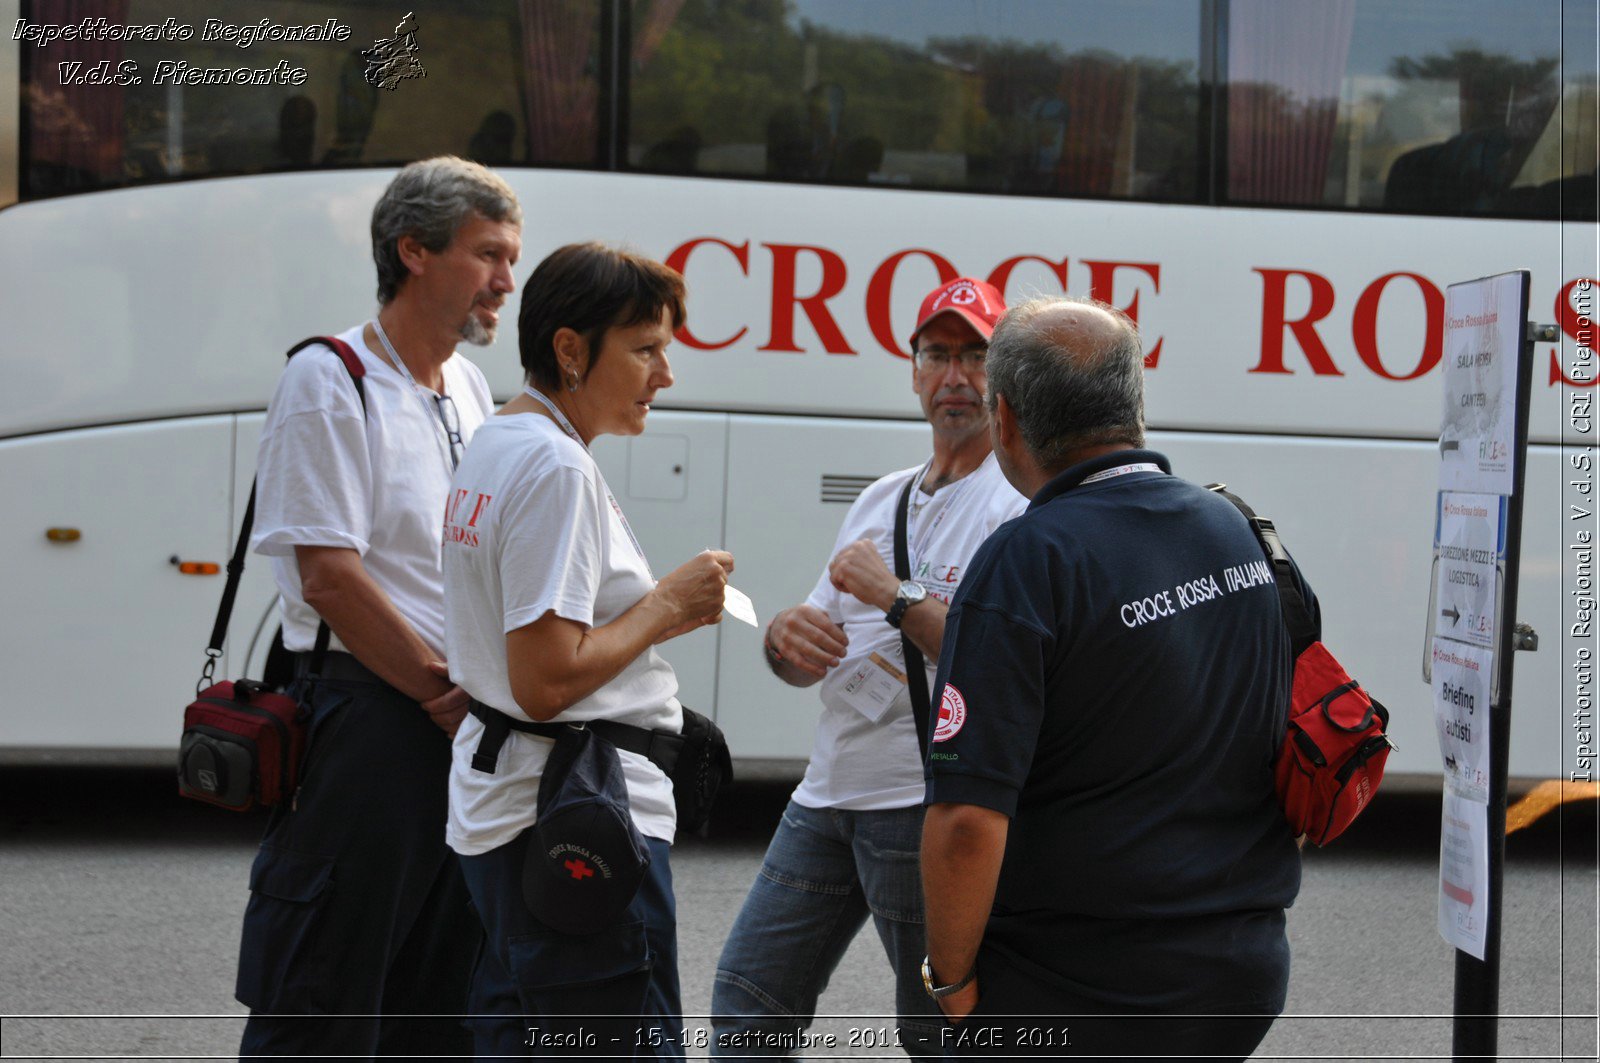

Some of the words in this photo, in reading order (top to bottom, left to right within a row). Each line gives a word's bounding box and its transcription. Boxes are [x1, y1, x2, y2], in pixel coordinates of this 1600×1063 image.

[1448, 318, 1465, 329] Croce
[1457, 354, 1474, 369] SALA
[1441, 545, 1469, 562] DIREZIONE
[1470, 548, 1490, 565] MEZZI
[1490, 551, 1495, 565] E
[1448, 569, 1480, 588] LOGISTICA
[1120, 590, 1177, 628] CROCE
[1175, 574, 1224, 610] ROSSA
[1223, 560, 1274, 593] ITALIANA
[1442, 682, 1475, 715] Briefing
[1446, 719, 1471, 744] autisti
